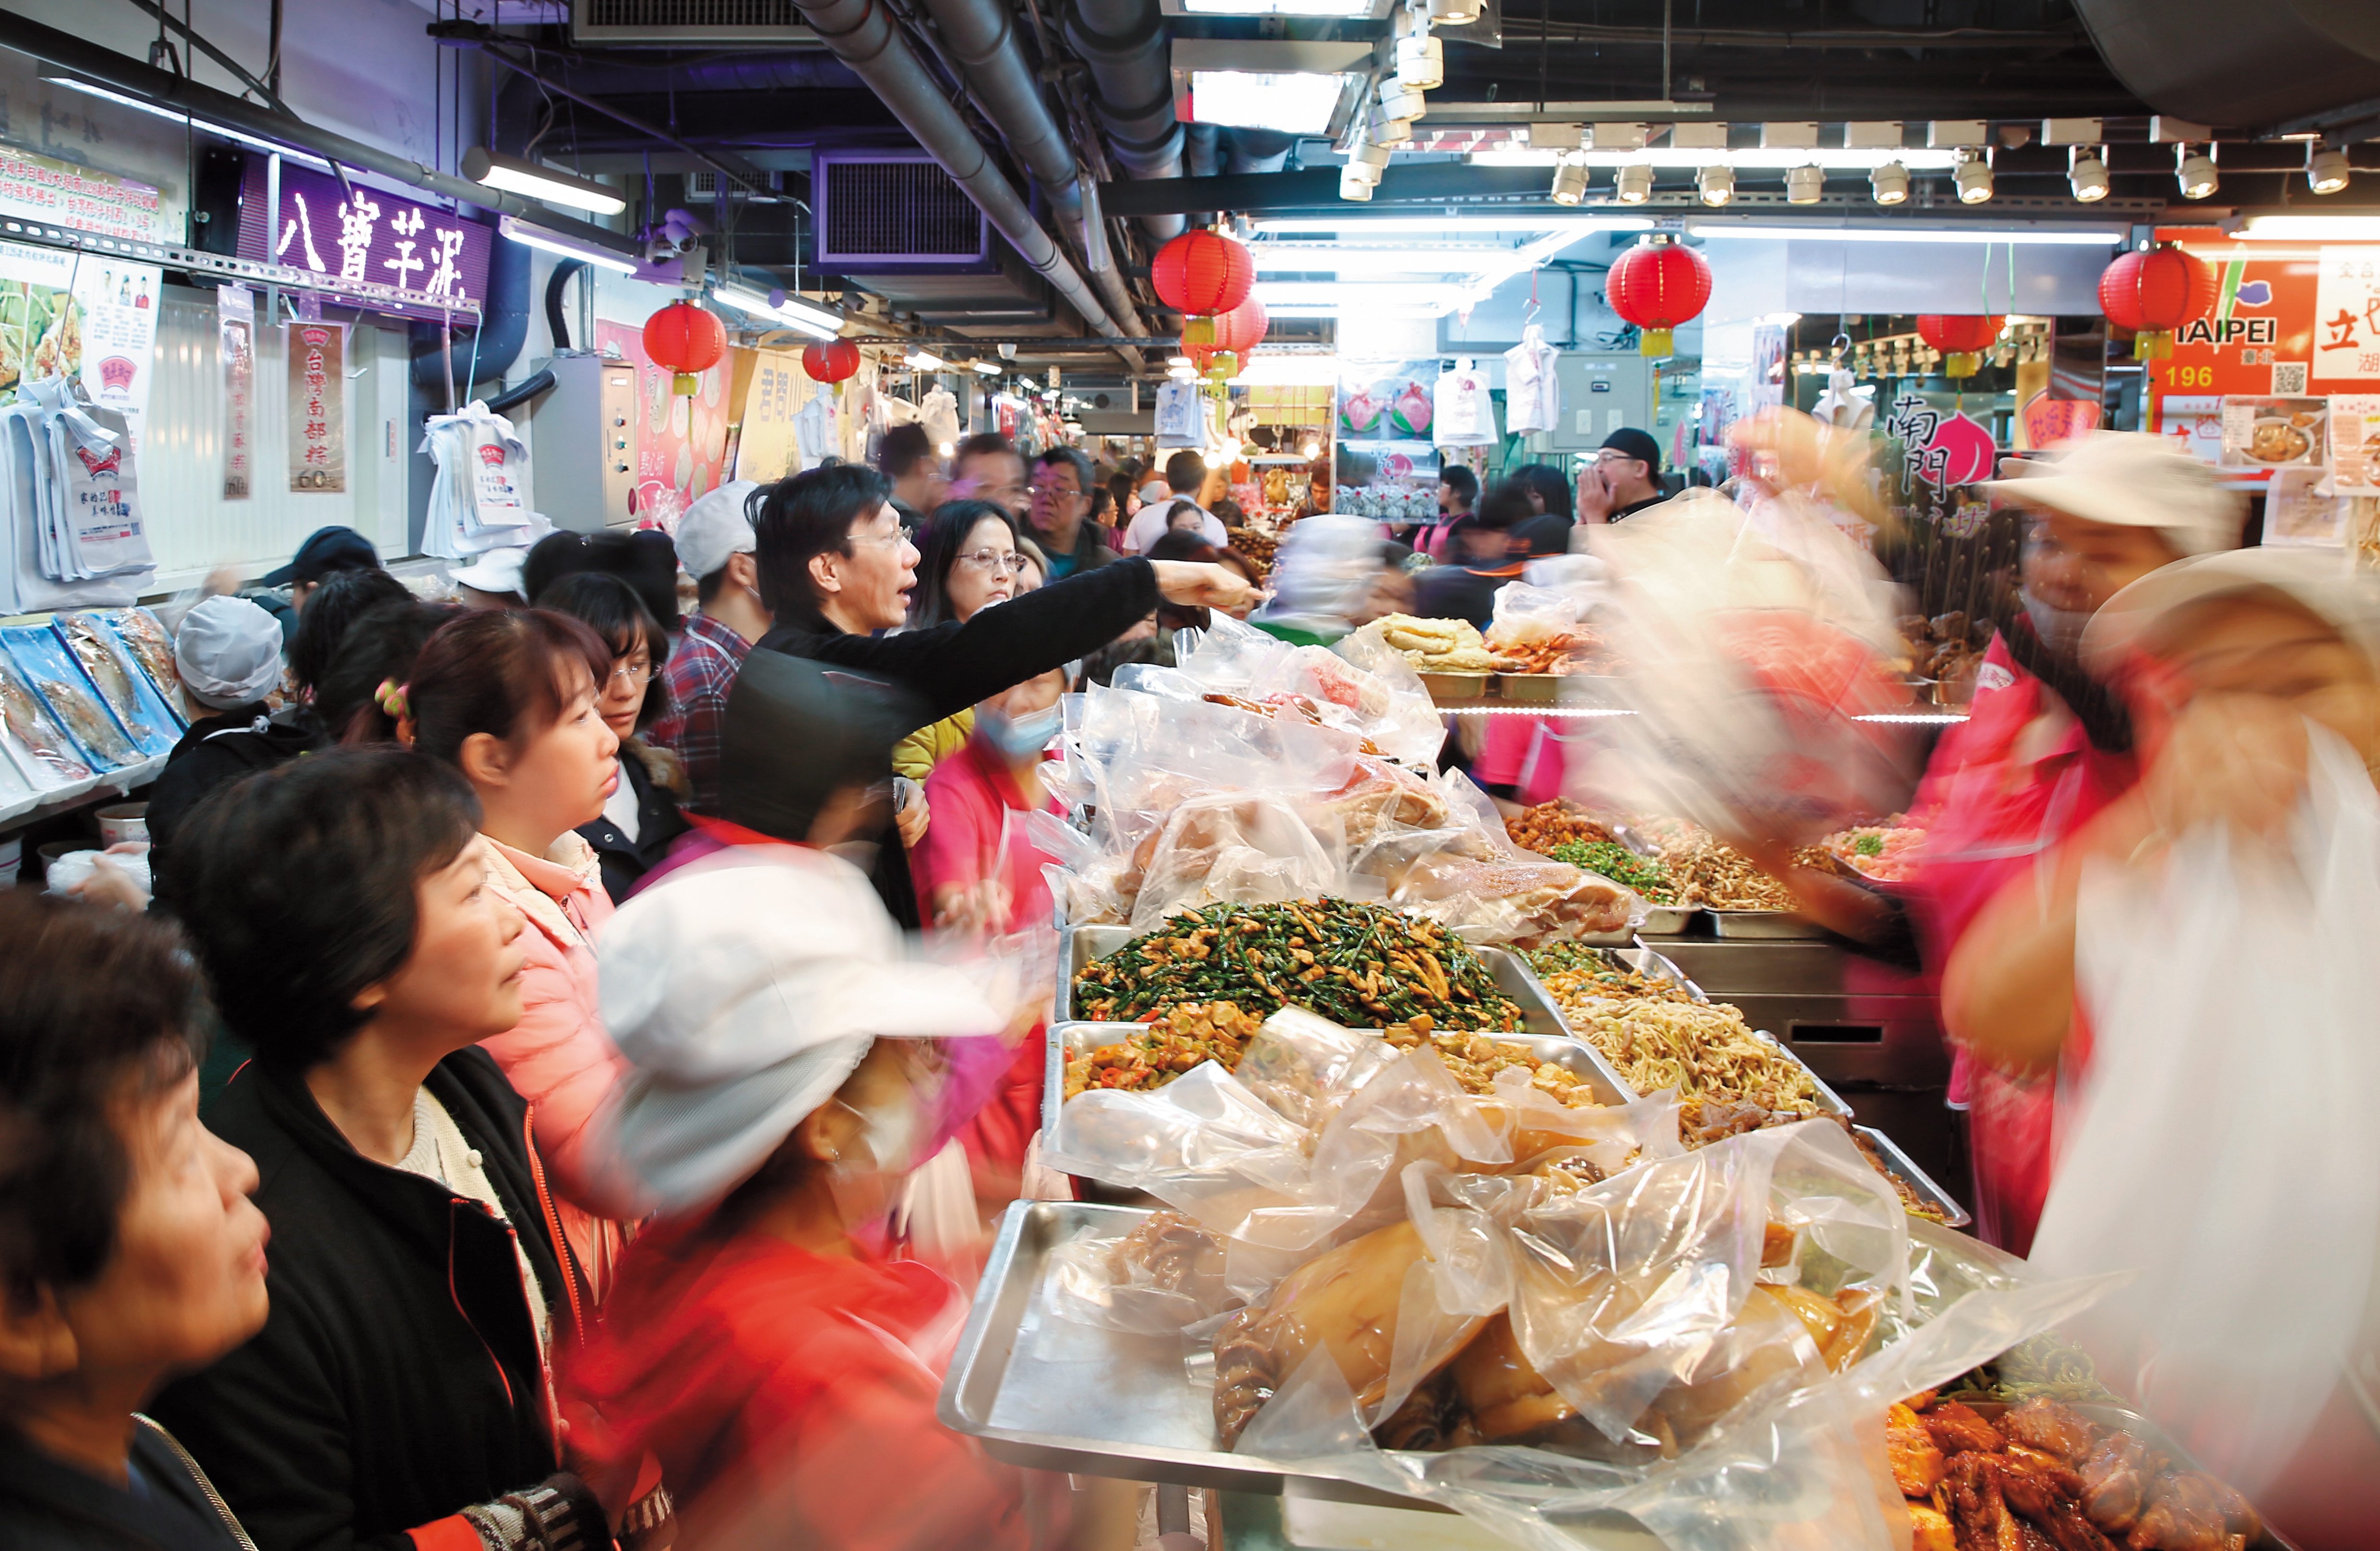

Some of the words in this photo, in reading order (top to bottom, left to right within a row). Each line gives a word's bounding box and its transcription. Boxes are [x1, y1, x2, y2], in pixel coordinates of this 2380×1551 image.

[2320, 308, 2360, 352] 立
[304, 349, 329, 465] 台灣南部粽
[2166, 366, 2213, 387] 196
[1885, 396, 1950, 504] 南門
